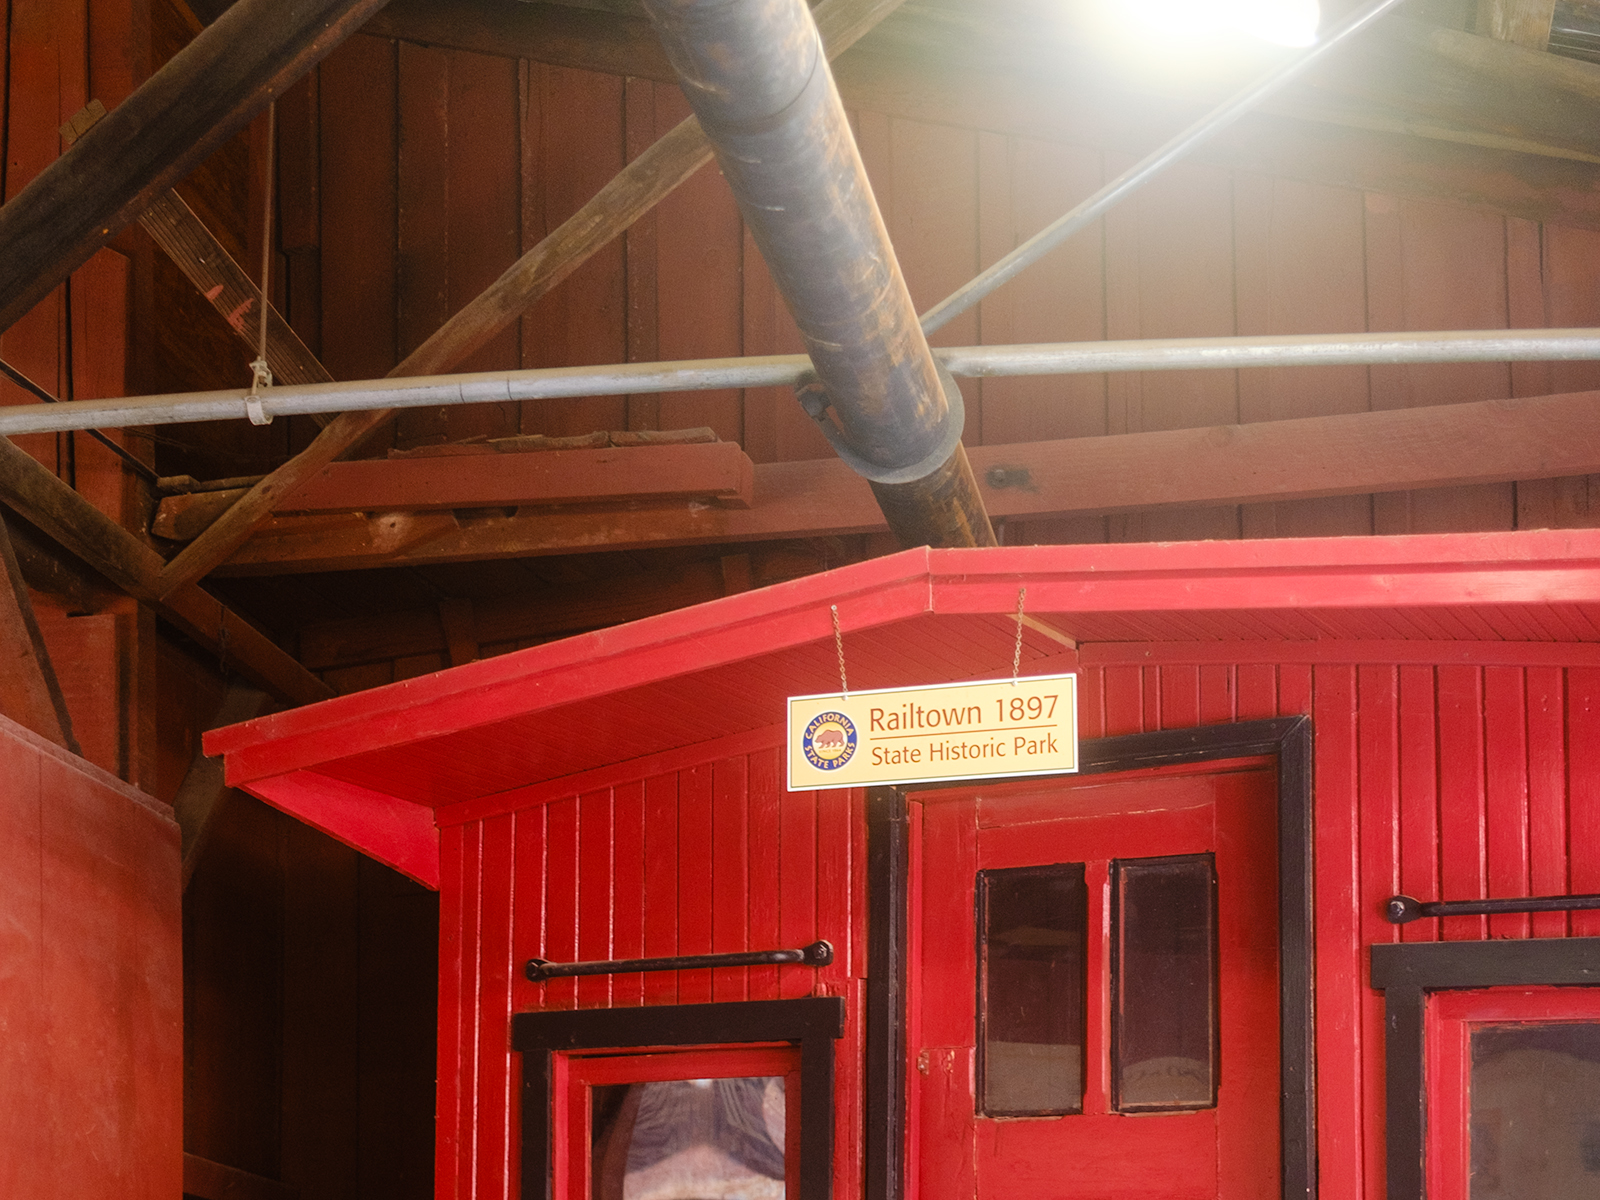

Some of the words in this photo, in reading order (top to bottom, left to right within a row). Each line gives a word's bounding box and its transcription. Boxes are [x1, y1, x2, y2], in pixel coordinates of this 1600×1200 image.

[805, 713, 854, 739] CALIFORNIA
[870, 702, 982, 732] Railtown
[996, 694, 1058, 723] 1897
[805, 745, 829, 769] STATE
[832, 742, 855, 768] PARKS
[872, 746, 921, 766] State
[929, 737, 1006, 762] Historic
[1014, 733, 1058, 755] Park
